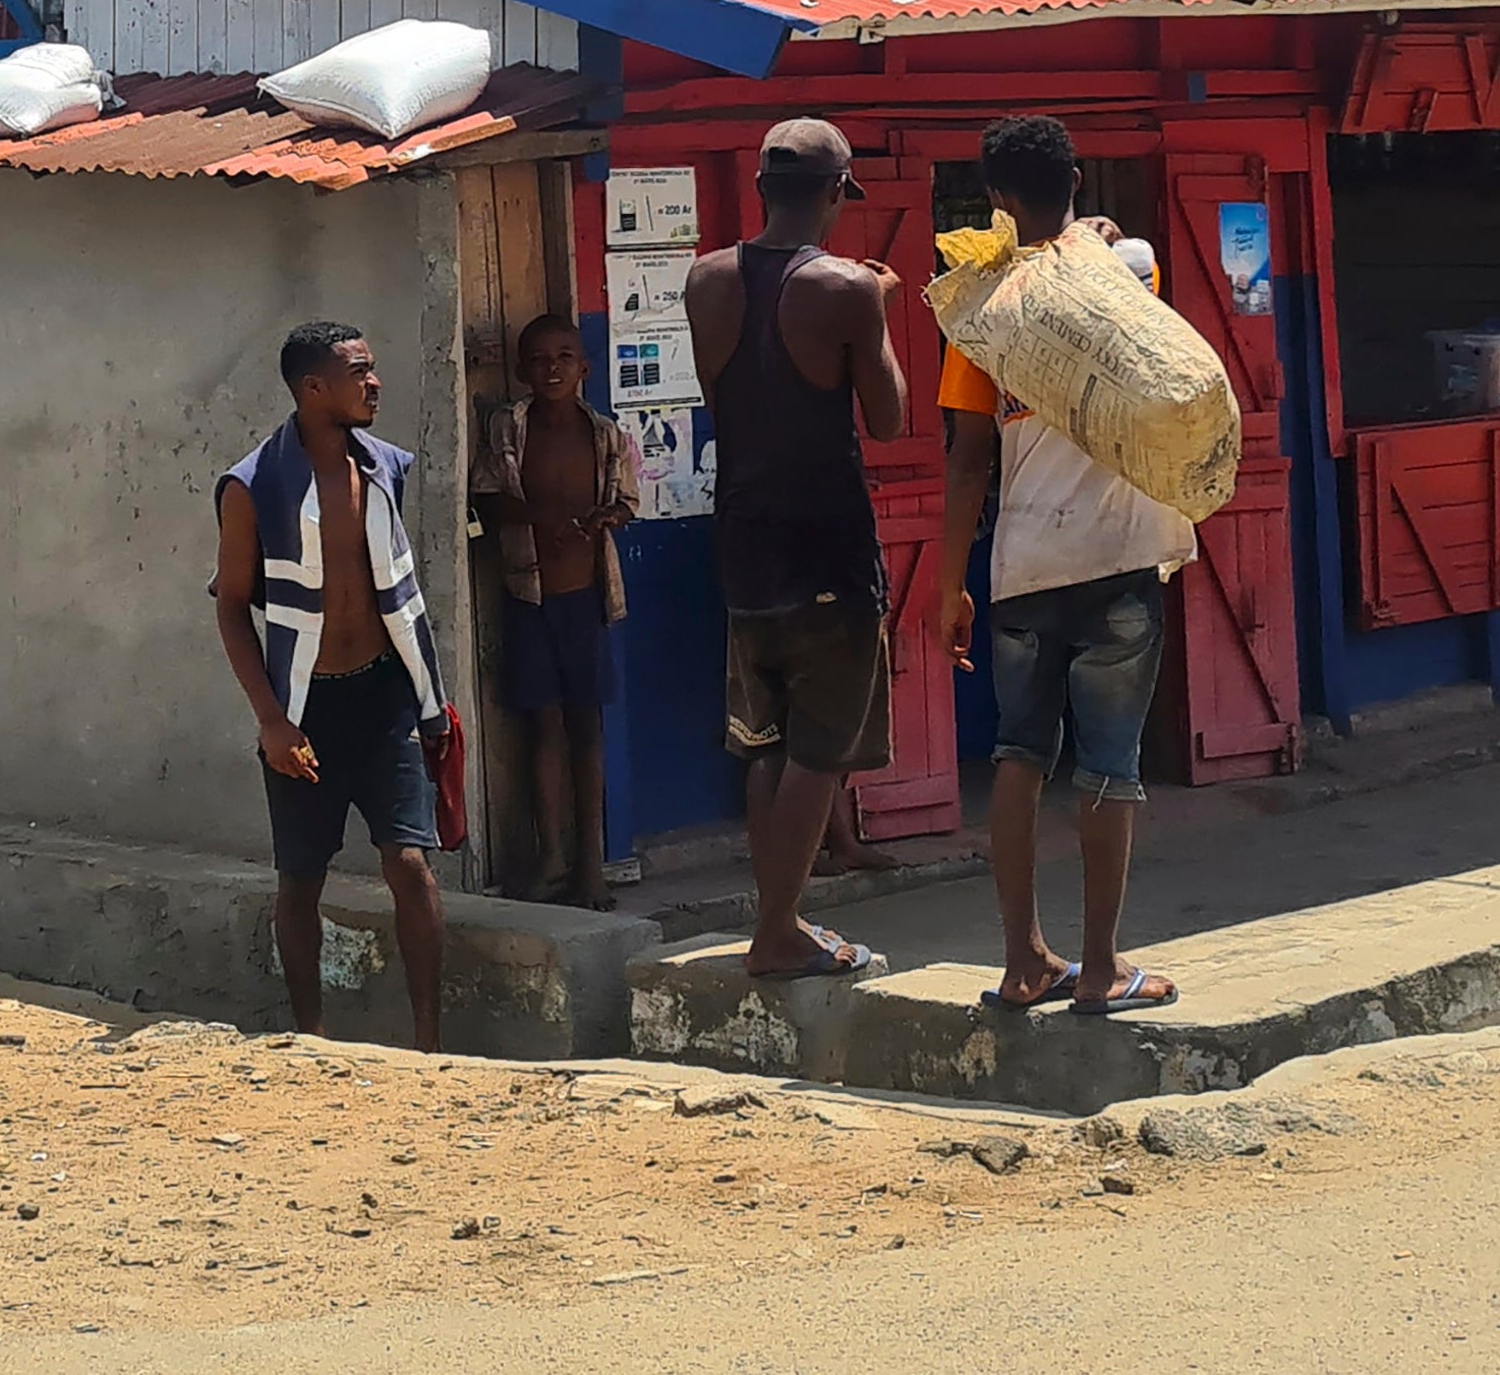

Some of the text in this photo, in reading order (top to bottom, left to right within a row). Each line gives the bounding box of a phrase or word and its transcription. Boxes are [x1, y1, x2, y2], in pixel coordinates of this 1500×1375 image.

[665, 205, 680, 215] 200
[662, 291, 678, 301] 250
[1039, 309, 1093, 355] CEMENT
[1092, 347, 1135, 385] LUCKY
